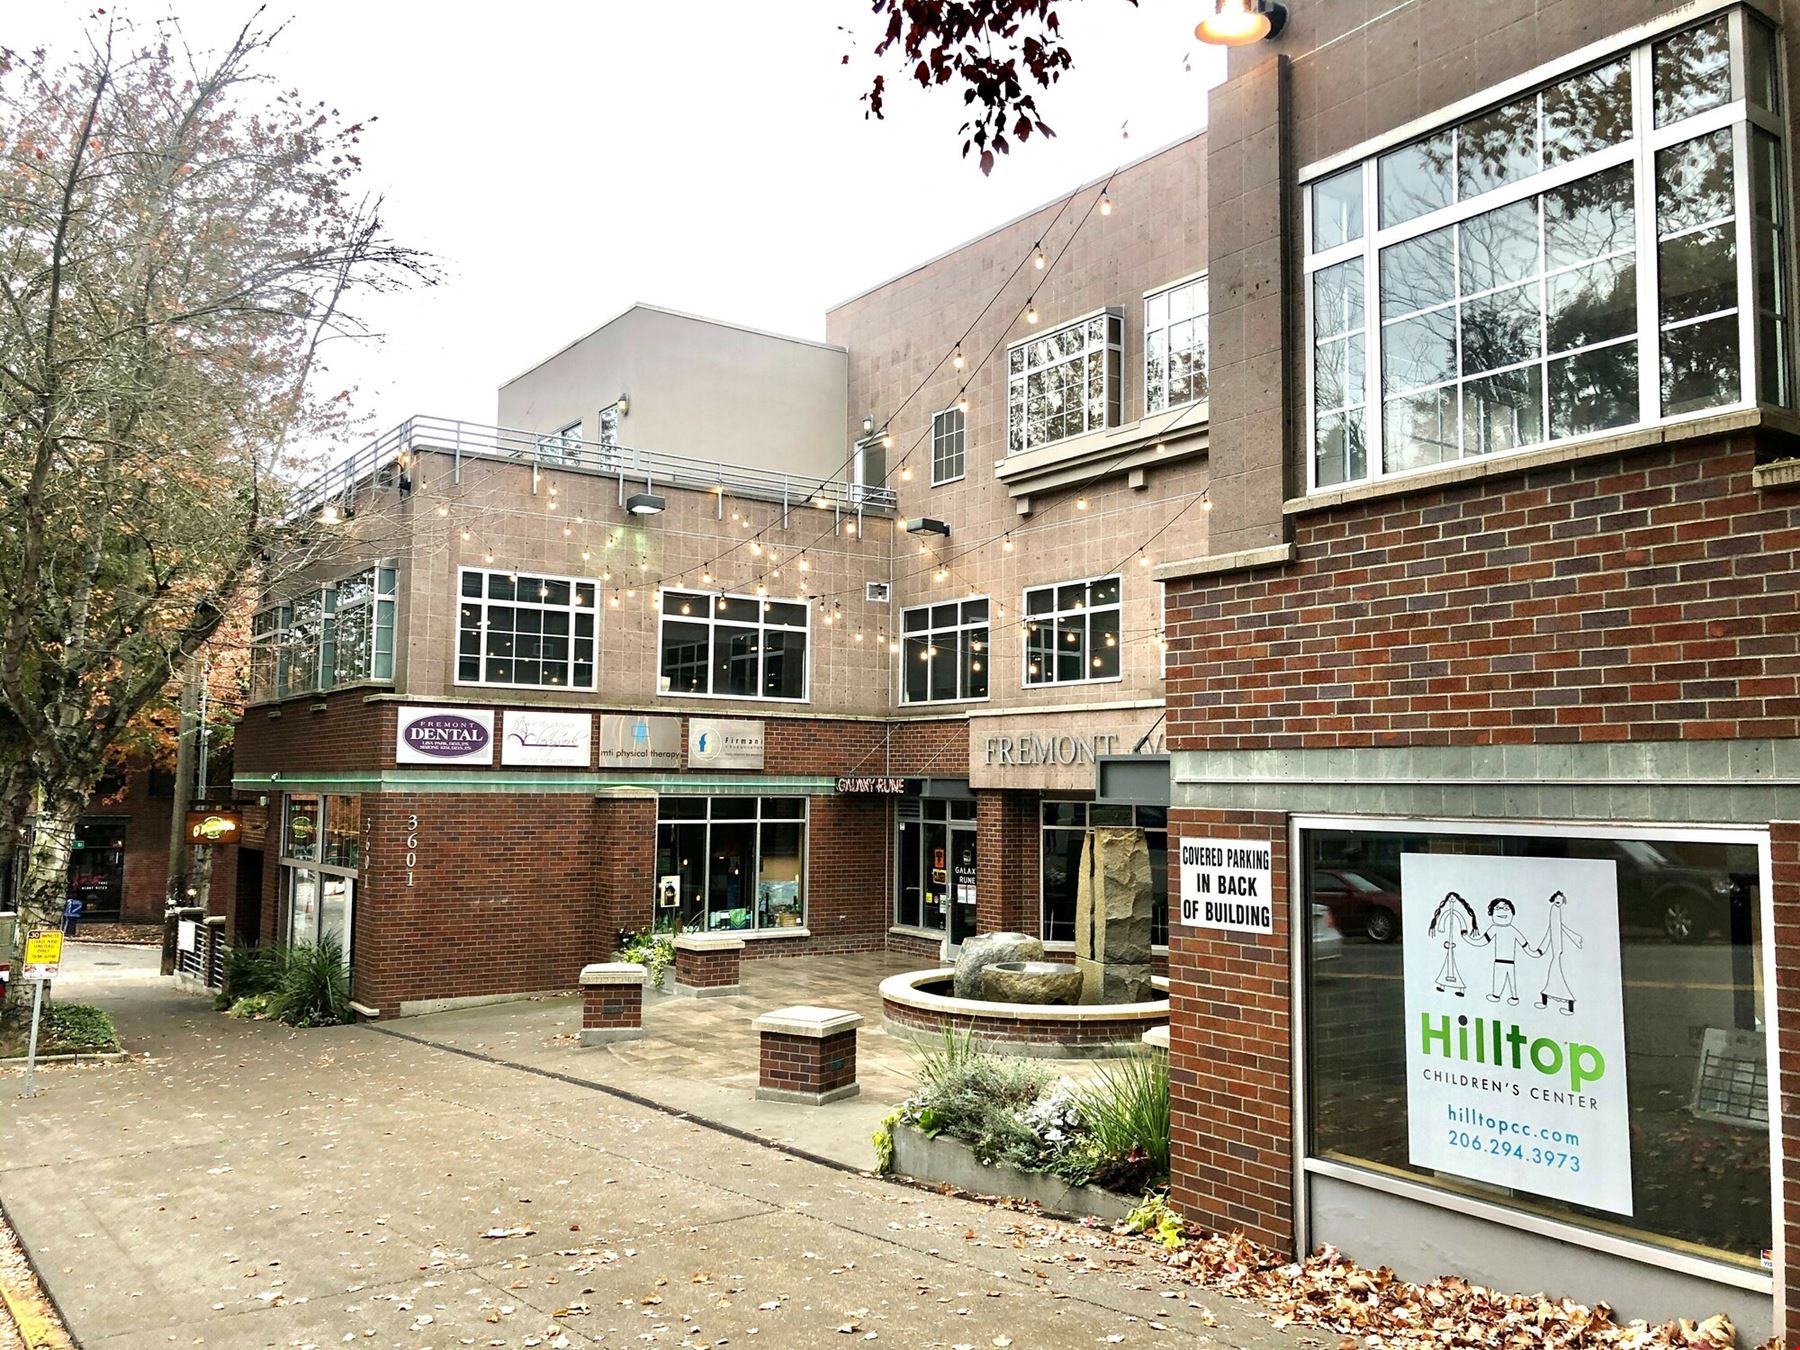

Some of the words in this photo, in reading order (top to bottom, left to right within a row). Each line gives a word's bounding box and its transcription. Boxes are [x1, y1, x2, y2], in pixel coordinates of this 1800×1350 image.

[410, 727, 484, 742] DENTAL
[616, 750, 648, 760] physical
[650, 750, 681, 760] therapy
[985, 734, 1115, 766] FREMONT
[838, 778, 875, 793] GALAXY
[876, 778, 904, 794] RUNE
[406, 814, 418, 887] 3601
[1182, 846, 1223, 868] COVERED
[1227, 848, 1269, 871] PARKING
[954, 866, 976, 875] GALAX
[959, 875, 976, 885] RUNE
[1197, 873, 1210, 894] IN
[1218, 875, 1258, 897] BACK
[1183, 899, 1199, 920] OF
[1205, 901, 1270, 928] BUILDING
[1421, 1012, 1606, 1093] Hilltop
[1423, 1068, 1520, 1096] CHILDREN'S
[1530, 1087, 1598, 1110] CENTER
[1448, 1104, 1579, 1146] hilltopcc.com
[1449, 1130, 1581, 1173] 206.294.3973
